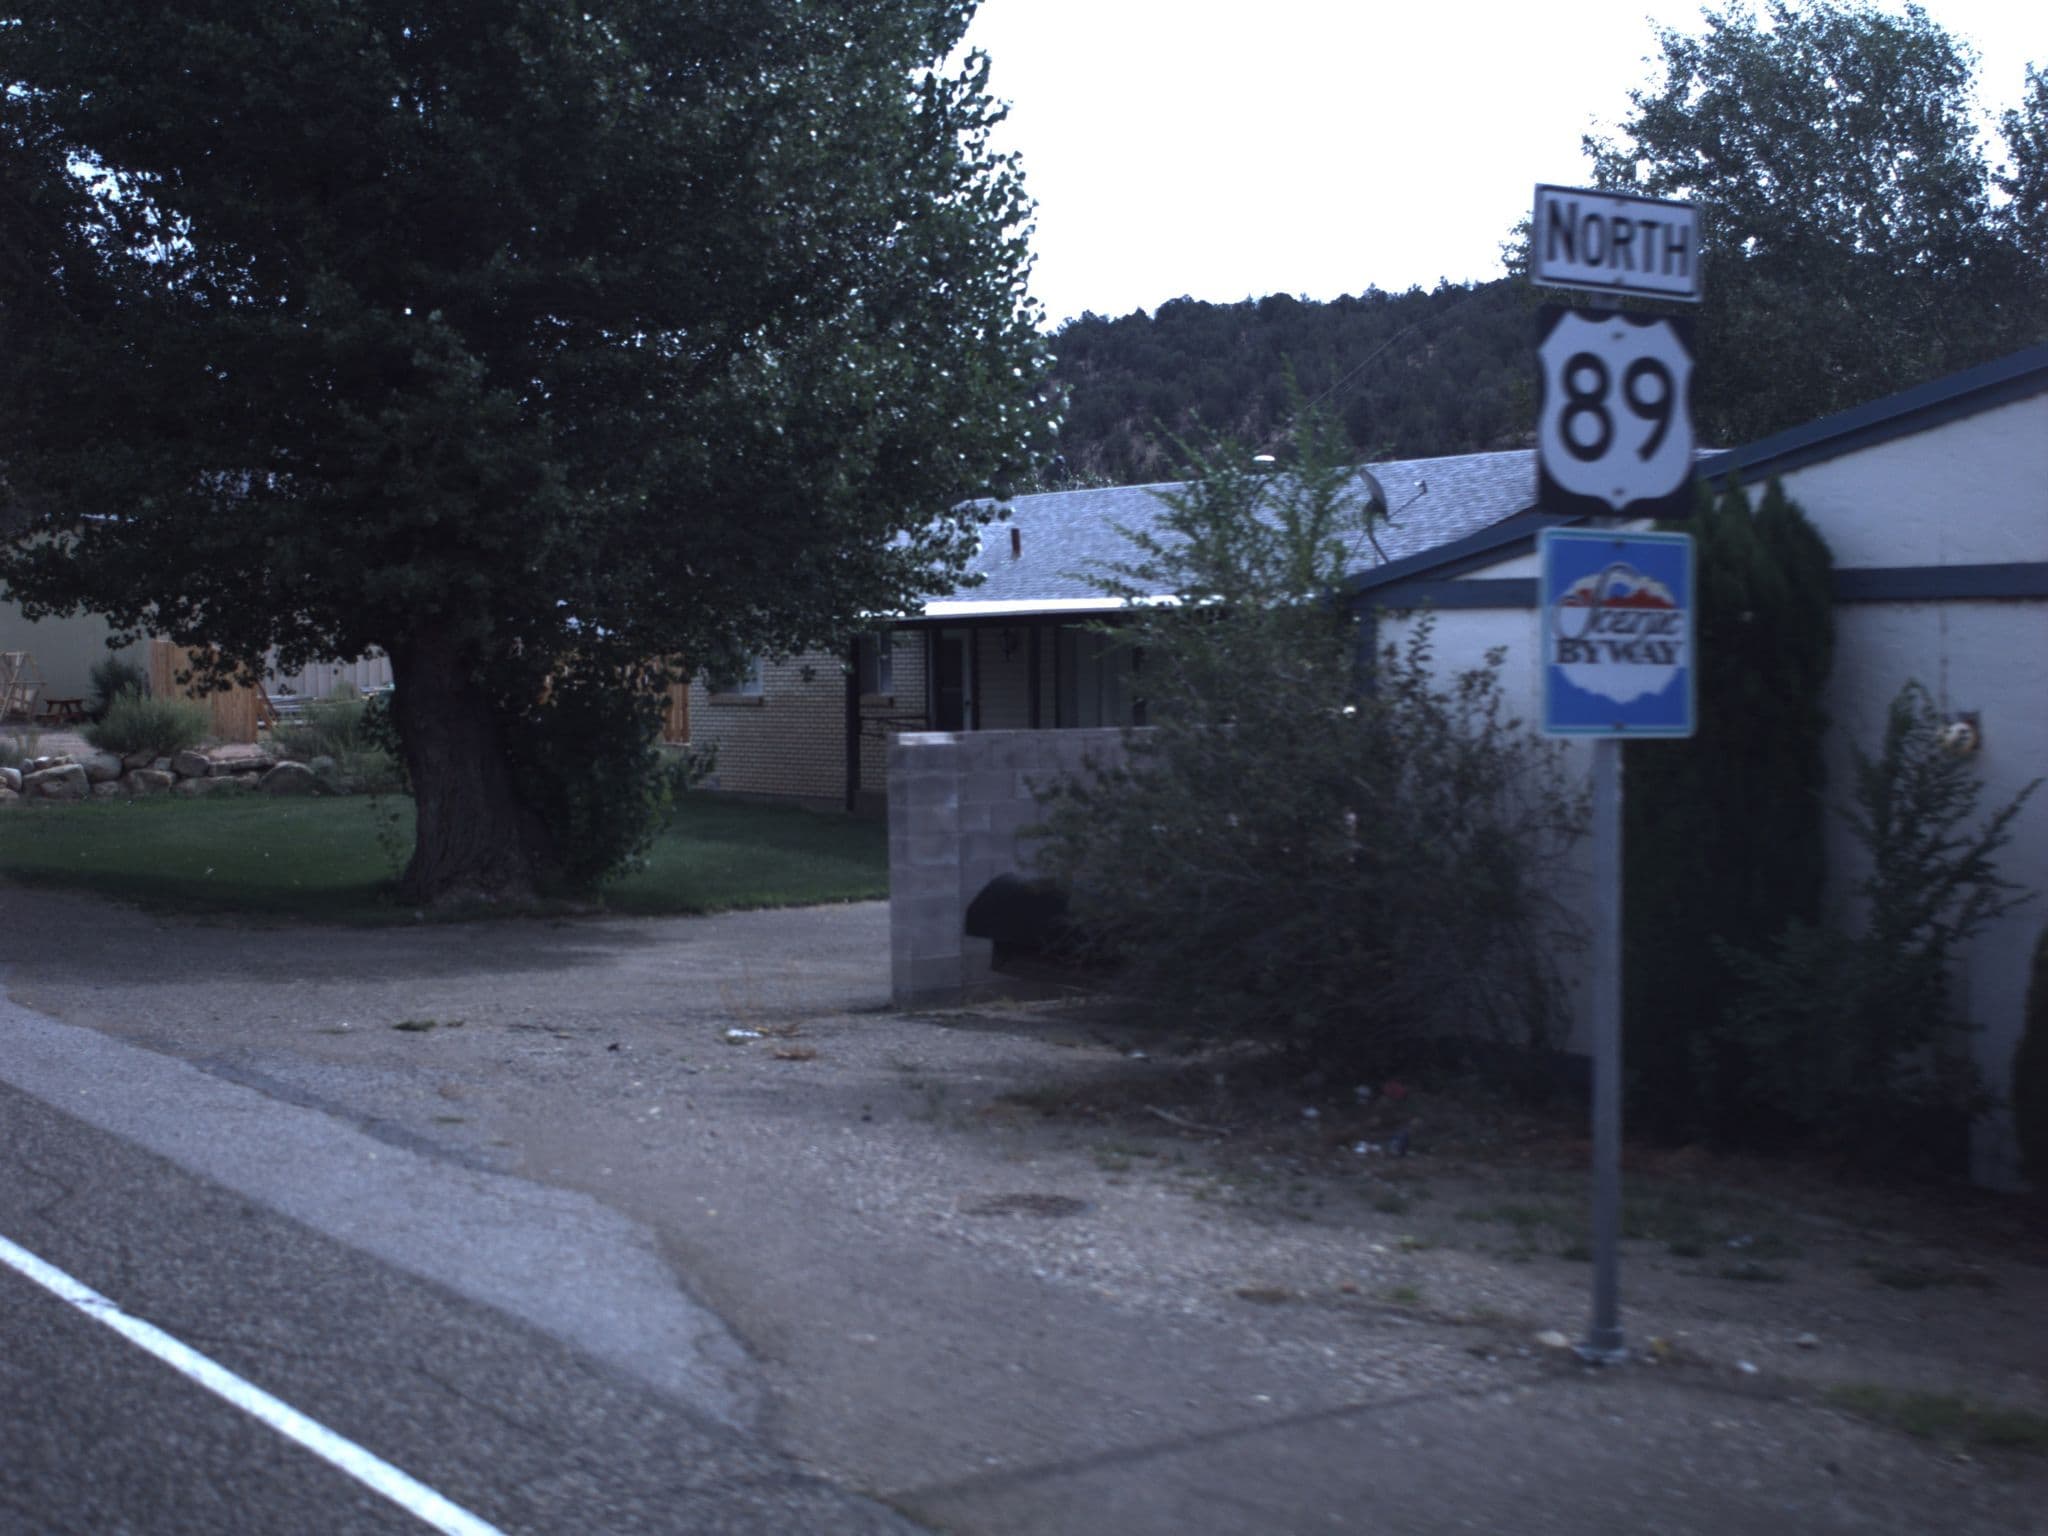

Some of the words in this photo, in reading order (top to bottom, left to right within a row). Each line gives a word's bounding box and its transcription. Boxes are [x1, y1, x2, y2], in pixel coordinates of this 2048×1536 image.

[1546, 200, 1690, 277] NORTH
[1560, 351, 1676, 463] 89
[1552, 562, 1681, 640] Scenic
[1556, 639, 1684, 665] BYWAY
